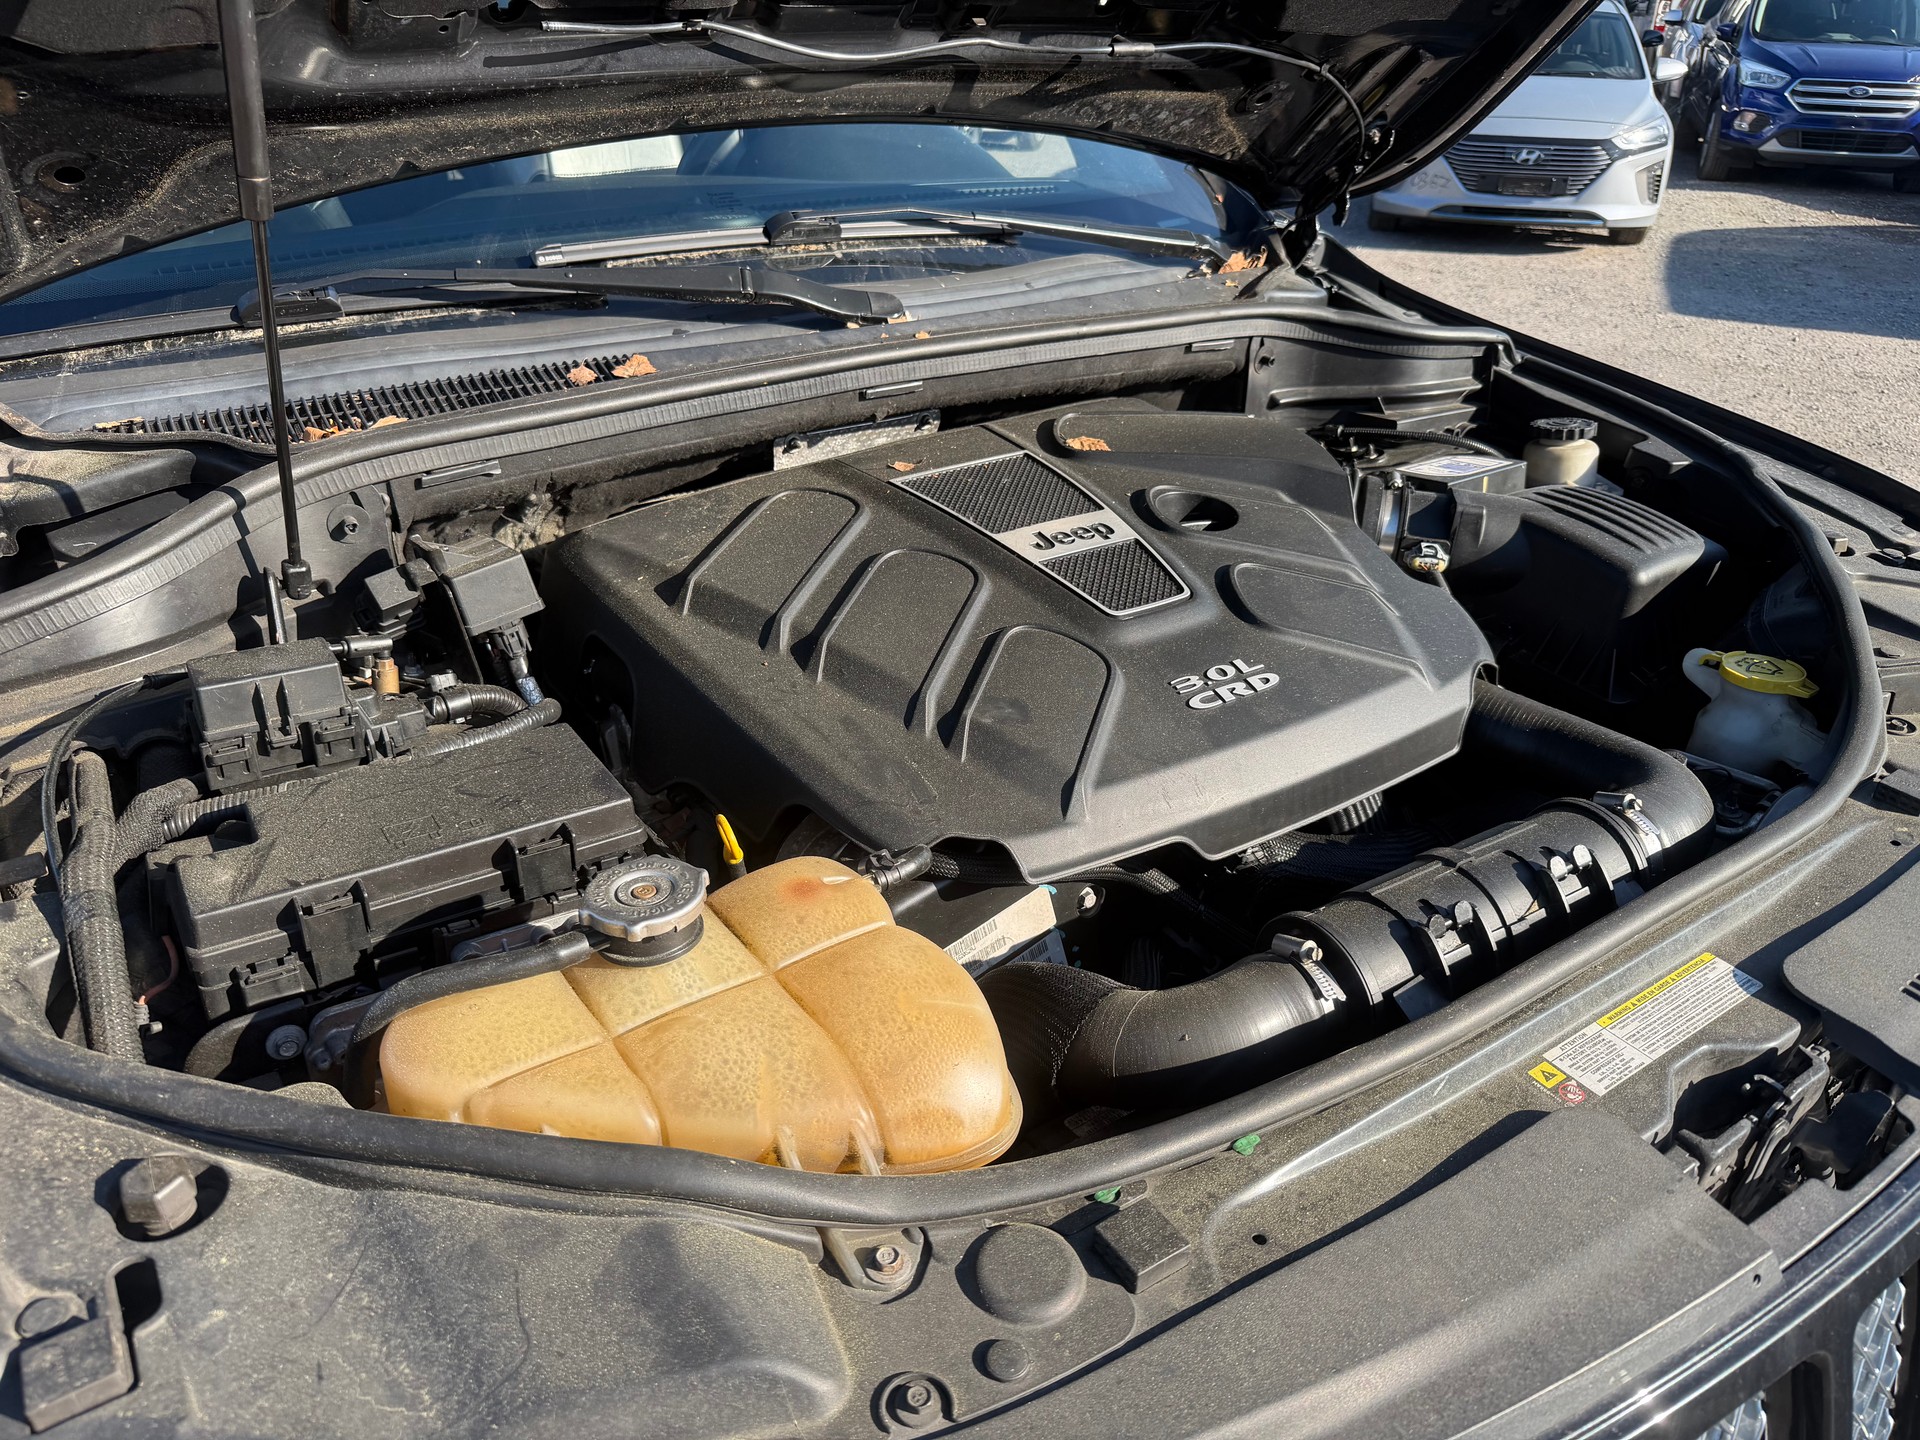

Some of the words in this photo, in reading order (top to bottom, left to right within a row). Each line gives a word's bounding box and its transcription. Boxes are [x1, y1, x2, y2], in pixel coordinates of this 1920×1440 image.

[1029, 522, 1115, 551] Jeep
[1168, 659, 1264, 694] 3.0L
[1186, 672, 1280, 709] CRD
[674, 880, 695, 905] KEEP
[1607, 1005, 1631, 1021] WARNING
[1635, 994, 1649, 1004] MISE
[1647, 989, 1656, 997] EN
[1654, 980, 1671, 991] GARDE
[1674, 958, 1705, 978] ADVERTENCIA
[1559, 1032, 1588, 1052] ATTENTION
